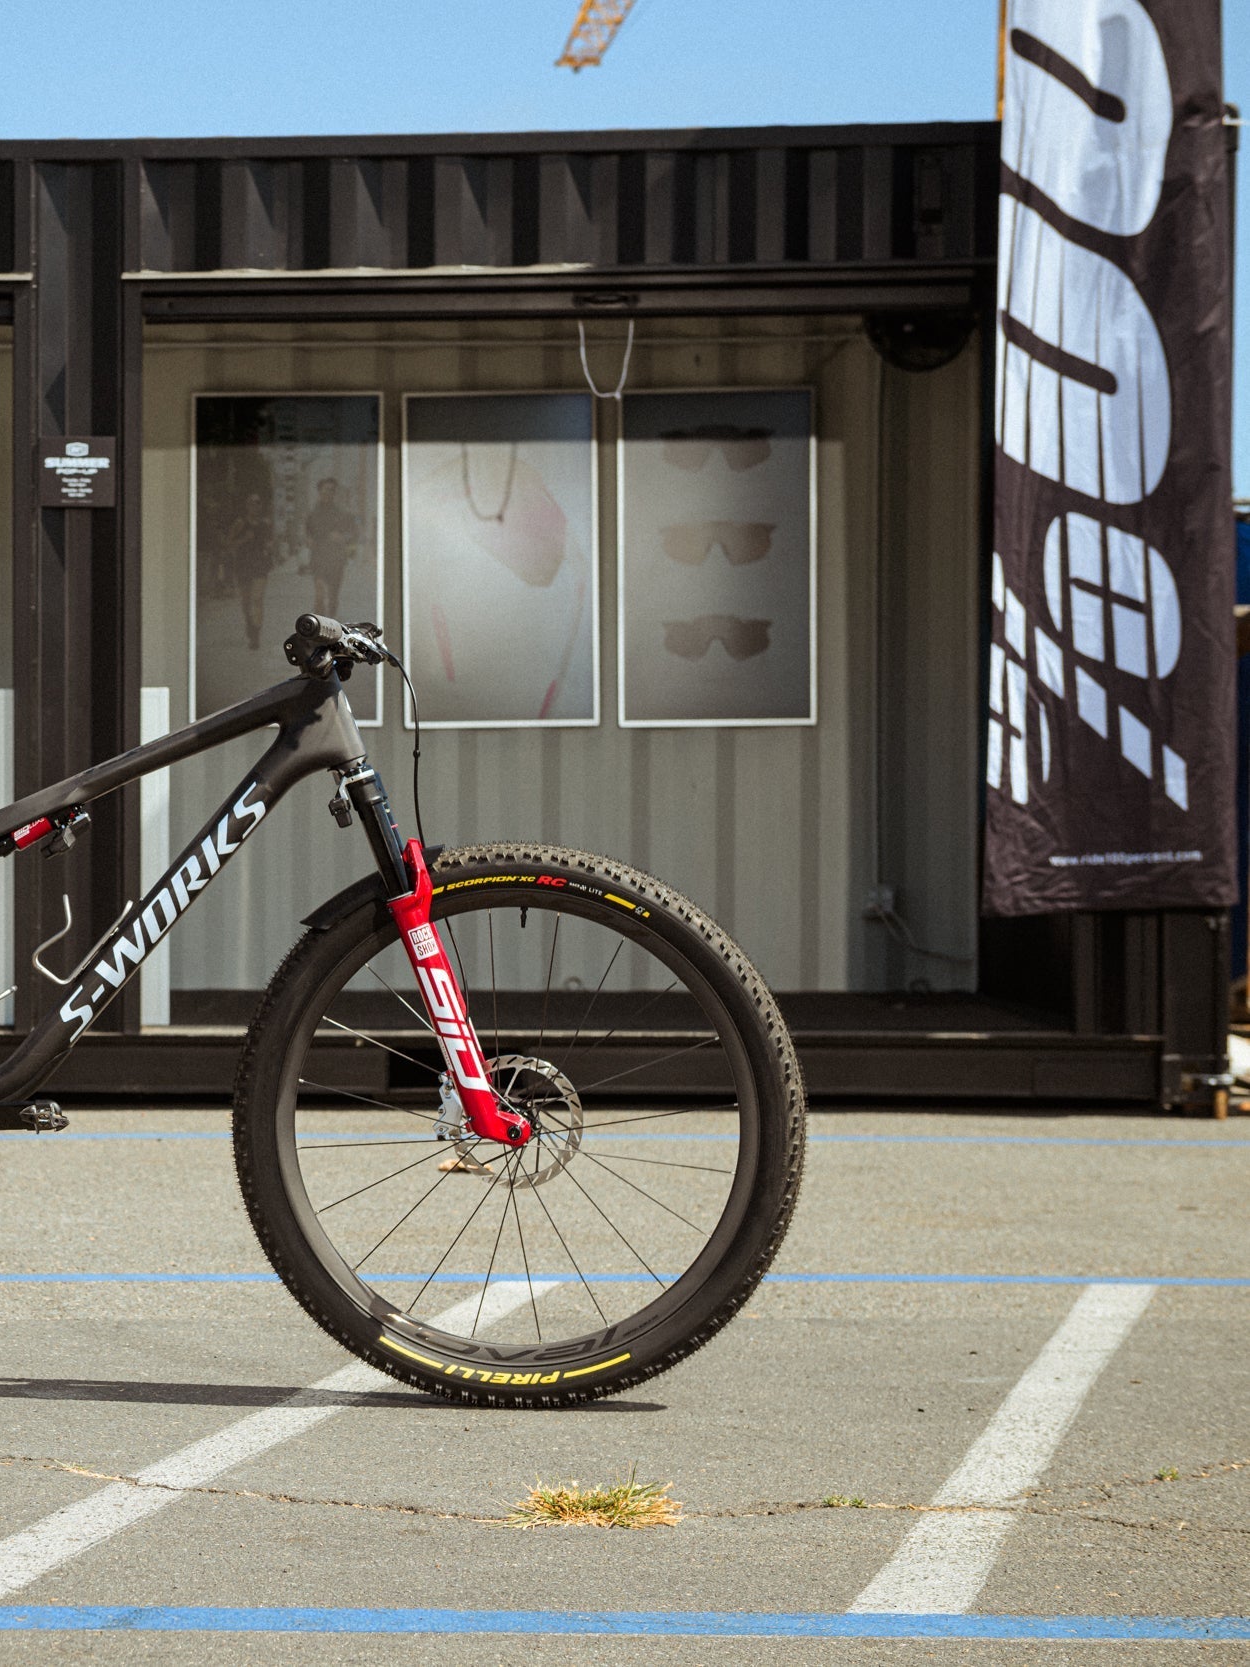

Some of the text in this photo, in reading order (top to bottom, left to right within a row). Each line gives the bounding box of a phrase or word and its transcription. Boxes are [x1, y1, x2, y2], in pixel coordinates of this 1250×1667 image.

[446, 875, 517, 891] SCORPION
[536, 874, 568, 888] RC
[588, 887, 603, 896] LITE
[59, 781, 266, 1042] S-WORKS
[411, 926, 433, 943] ROCK
[444, 1363, 561, 1385] PIRELLI
